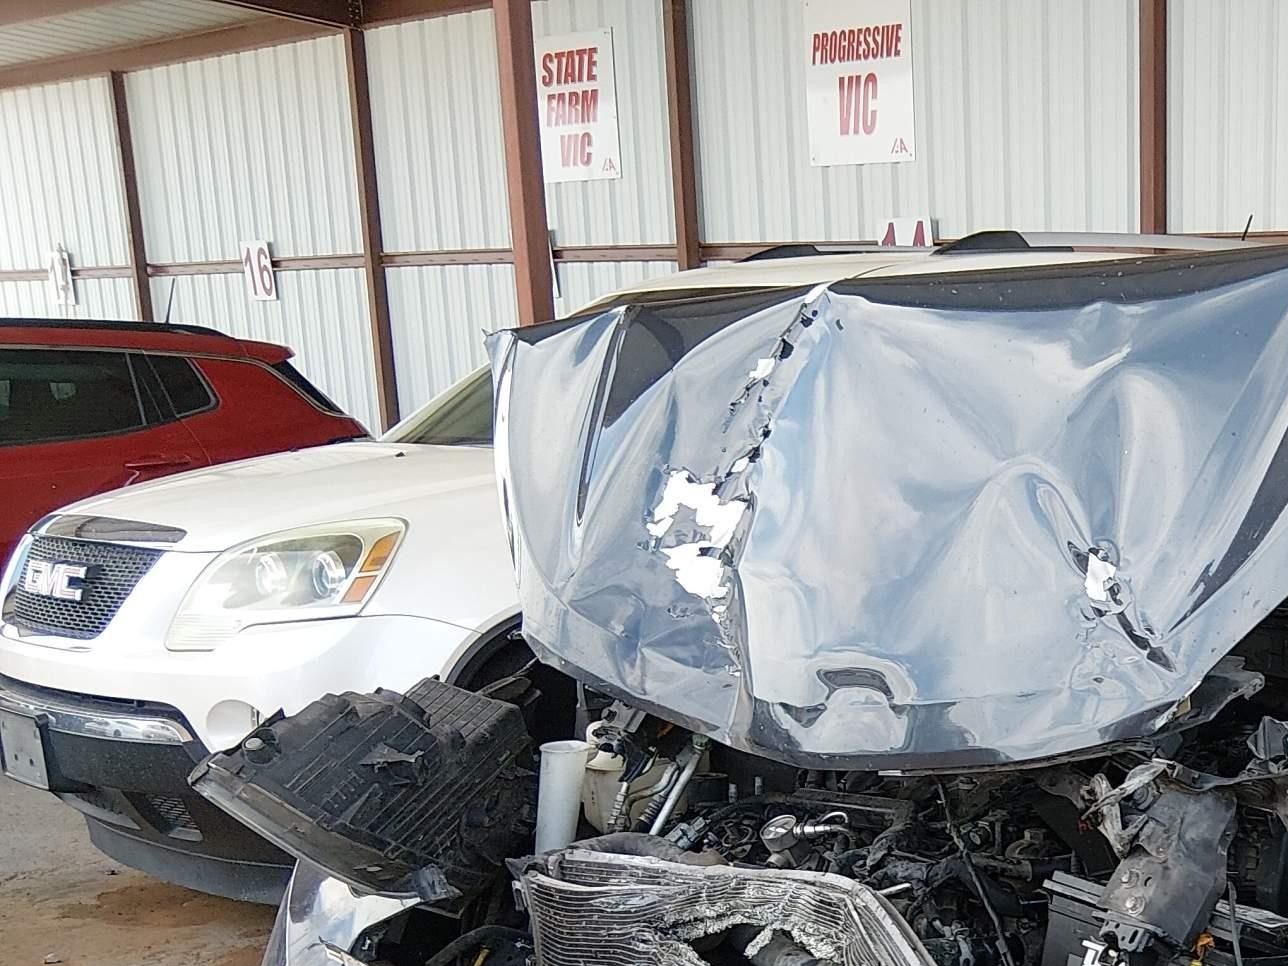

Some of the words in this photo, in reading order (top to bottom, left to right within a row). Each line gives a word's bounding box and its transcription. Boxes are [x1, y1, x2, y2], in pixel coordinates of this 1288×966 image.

[812, 23, 902, 65] PROGRESSIVE
[541, 47, 598, 87] STATE
[546, 89, 599, 127] FARM
[838, 72, 878, 136] VIC
[560, 132, 593, 168] VIC
[244, 246, 273, 297] 16
[24, 558, 87, 601] GMC
